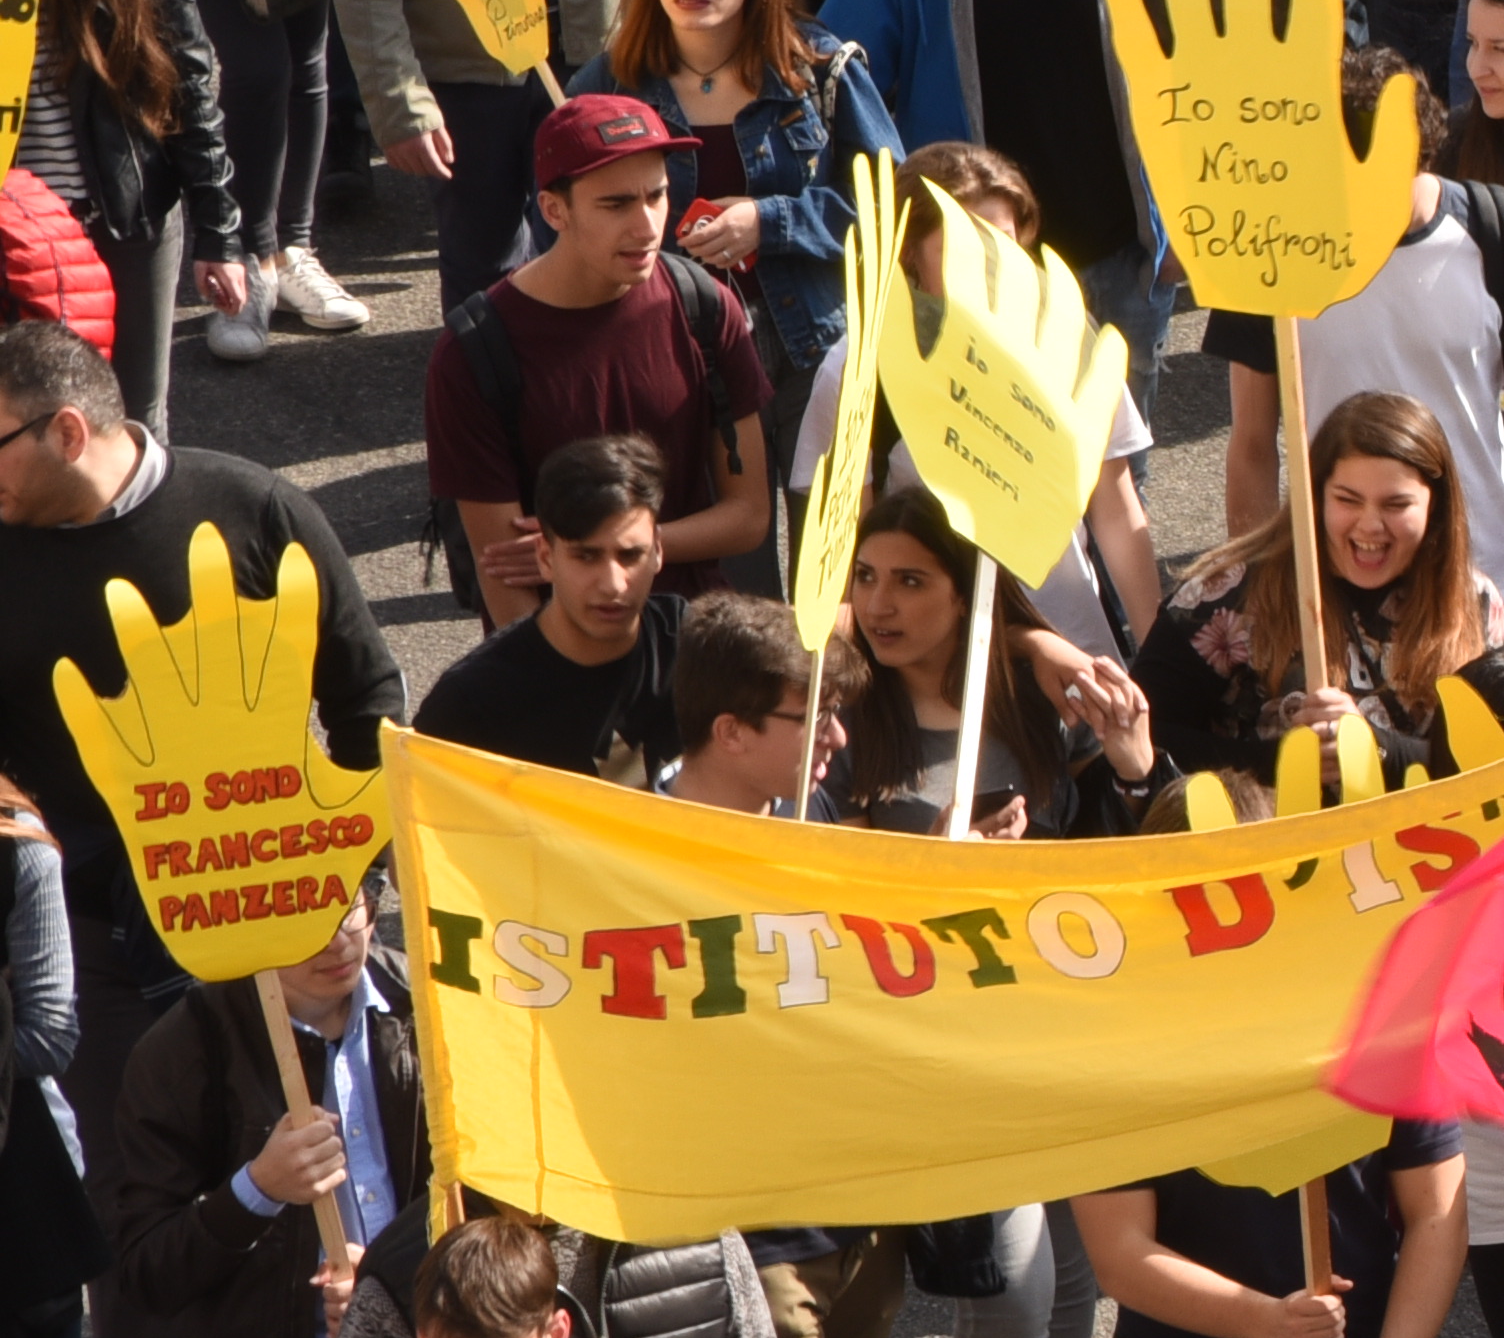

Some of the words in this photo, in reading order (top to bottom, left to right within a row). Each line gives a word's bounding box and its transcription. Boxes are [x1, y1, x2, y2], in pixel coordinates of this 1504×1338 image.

[1159, 84, 1215, 126] Io
[1241, 95, 1321, 127] sono
[1199, 143, 1289, 185] Nino
[1180, 203, 1356, 287] Polifroni
[135, 782, 191, 824] IO
[143, 814, 374, 881] FRANCESCO
[158, 873, 350, 934] PANZERA
[428, 891, 1127, 1021] ISTITUTO
